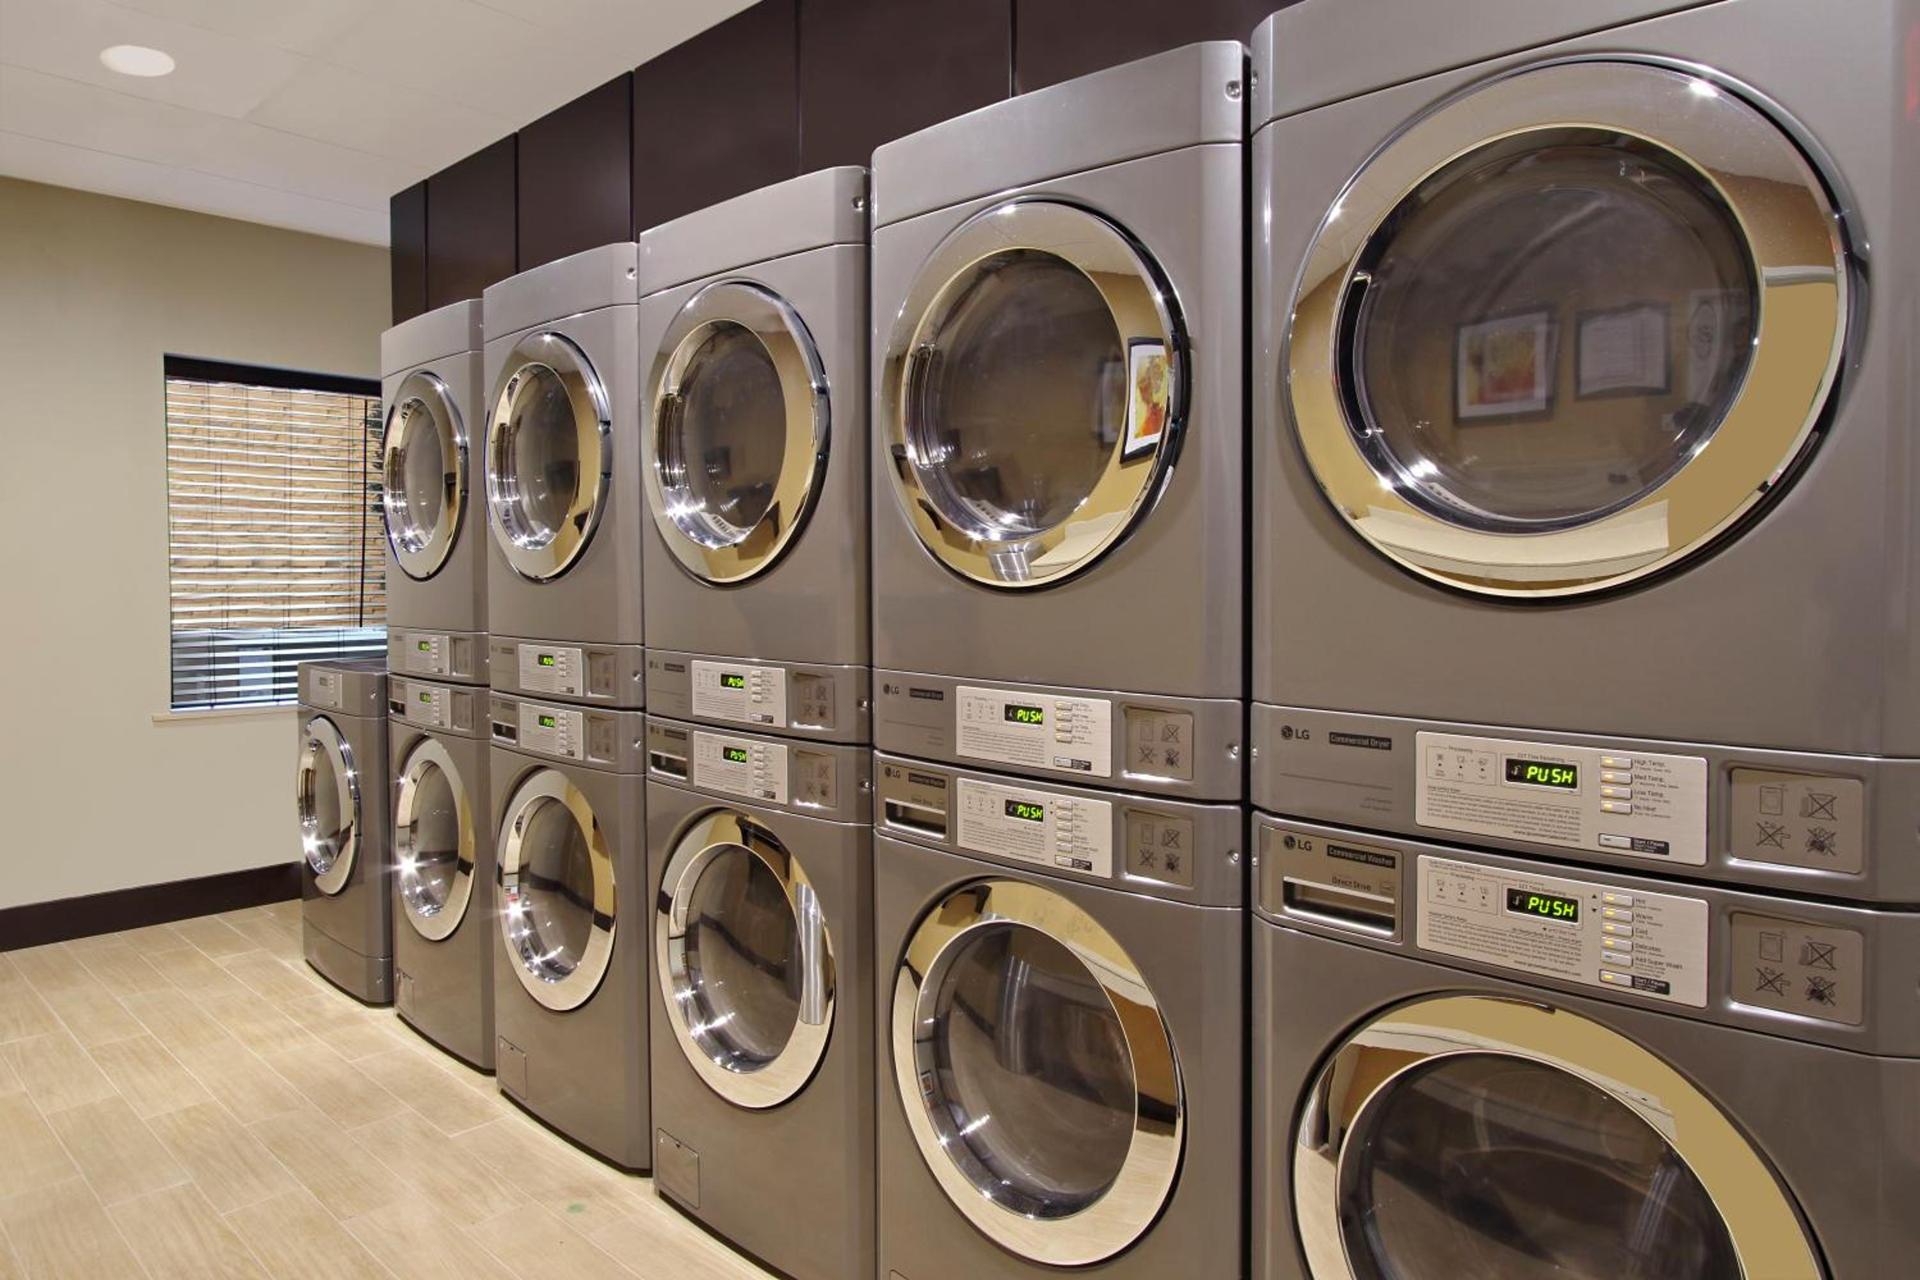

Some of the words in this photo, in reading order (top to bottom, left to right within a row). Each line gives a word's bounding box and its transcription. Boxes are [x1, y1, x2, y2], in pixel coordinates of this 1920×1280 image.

[1017, 709, 1043, 722] PUSH
[1295, 728, 1310, 740] LG
[1330, 733, 1369, 747] Commercial
[1370, 738, 1392, 750] Dryer
[1526, 765, 1574, 784] PUSH
[1017, 804, 1043, 819] PUSH
[1297, 839, 1312, 852] LG
[1329, 846, 1367, 862] Commercial
[1367, 853, 1394, 867] Washer
[1528, 896, 1575, 917] PUSH
